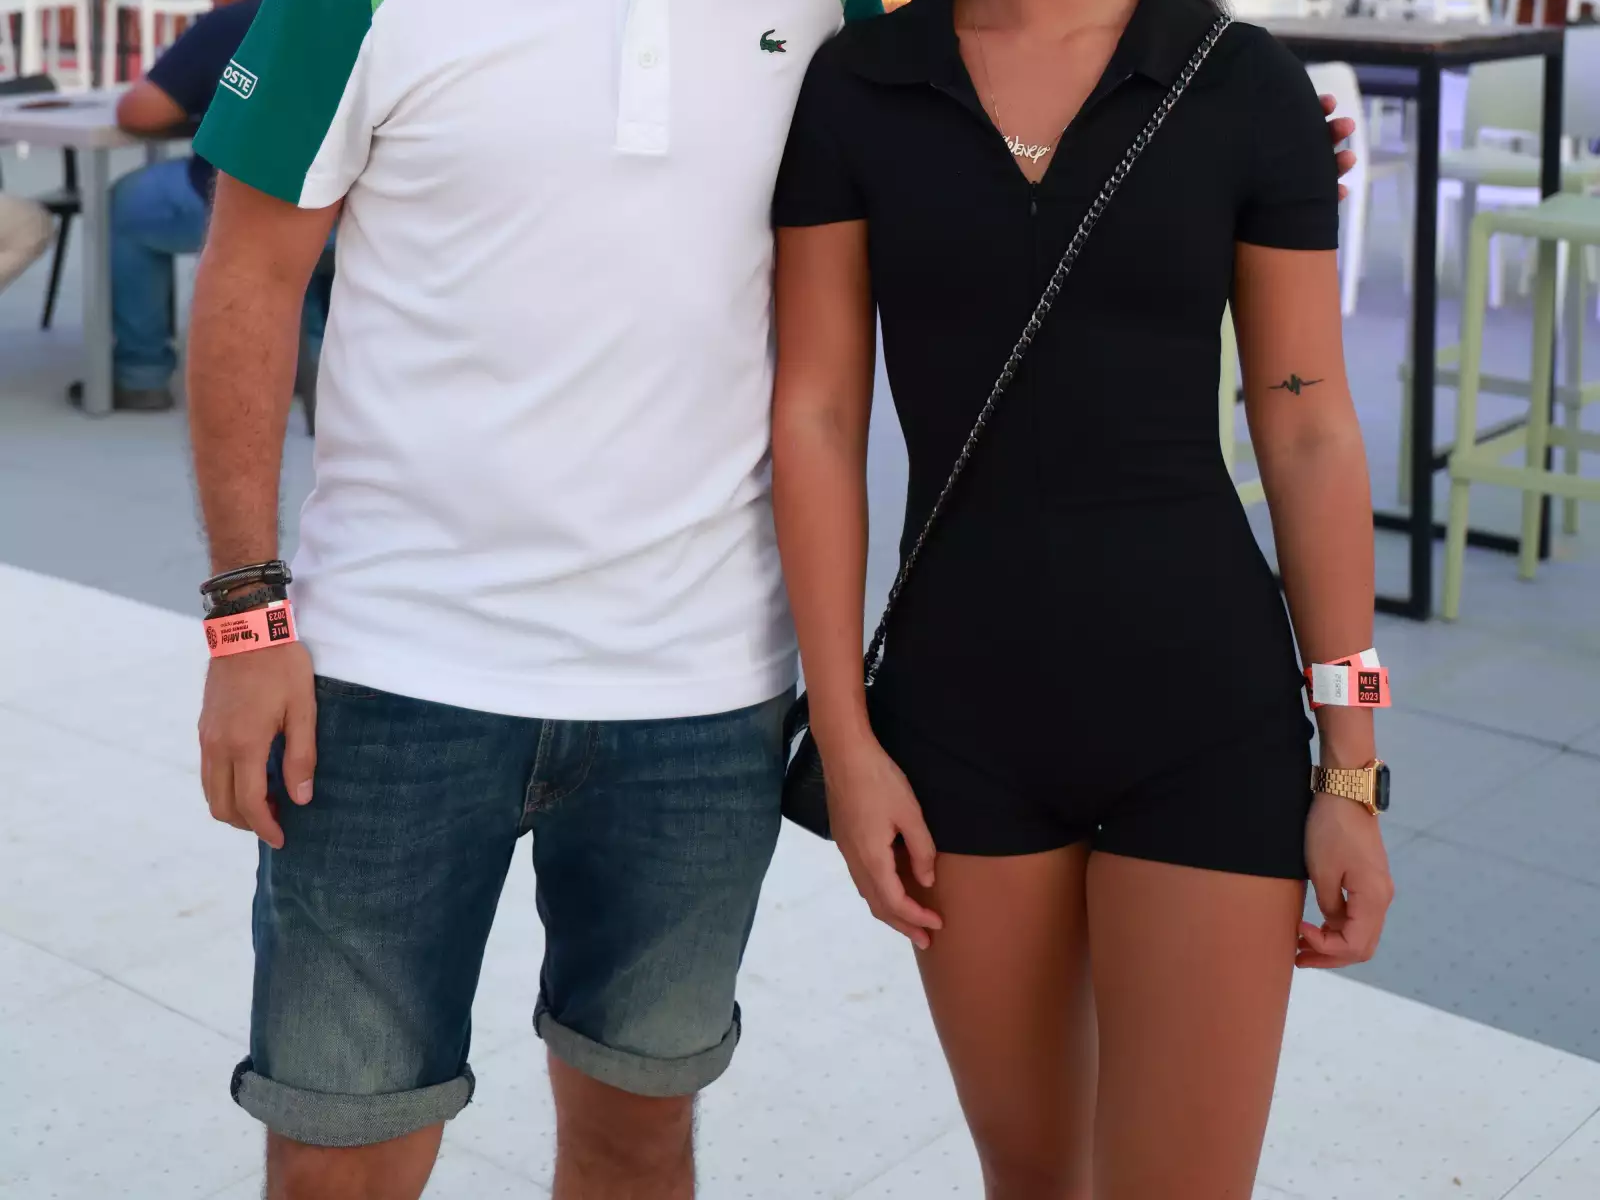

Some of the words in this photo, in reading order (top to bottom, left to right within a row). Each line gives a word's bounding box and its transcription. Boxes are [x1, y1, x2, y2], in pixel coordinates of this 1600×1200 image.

[223, 66, 252, 93] OSTE
[269, 611, 285, 621] 2023
[1360, 675, 1378, 685] MIÉ
[1360, 692, 1378, 701] 2023
